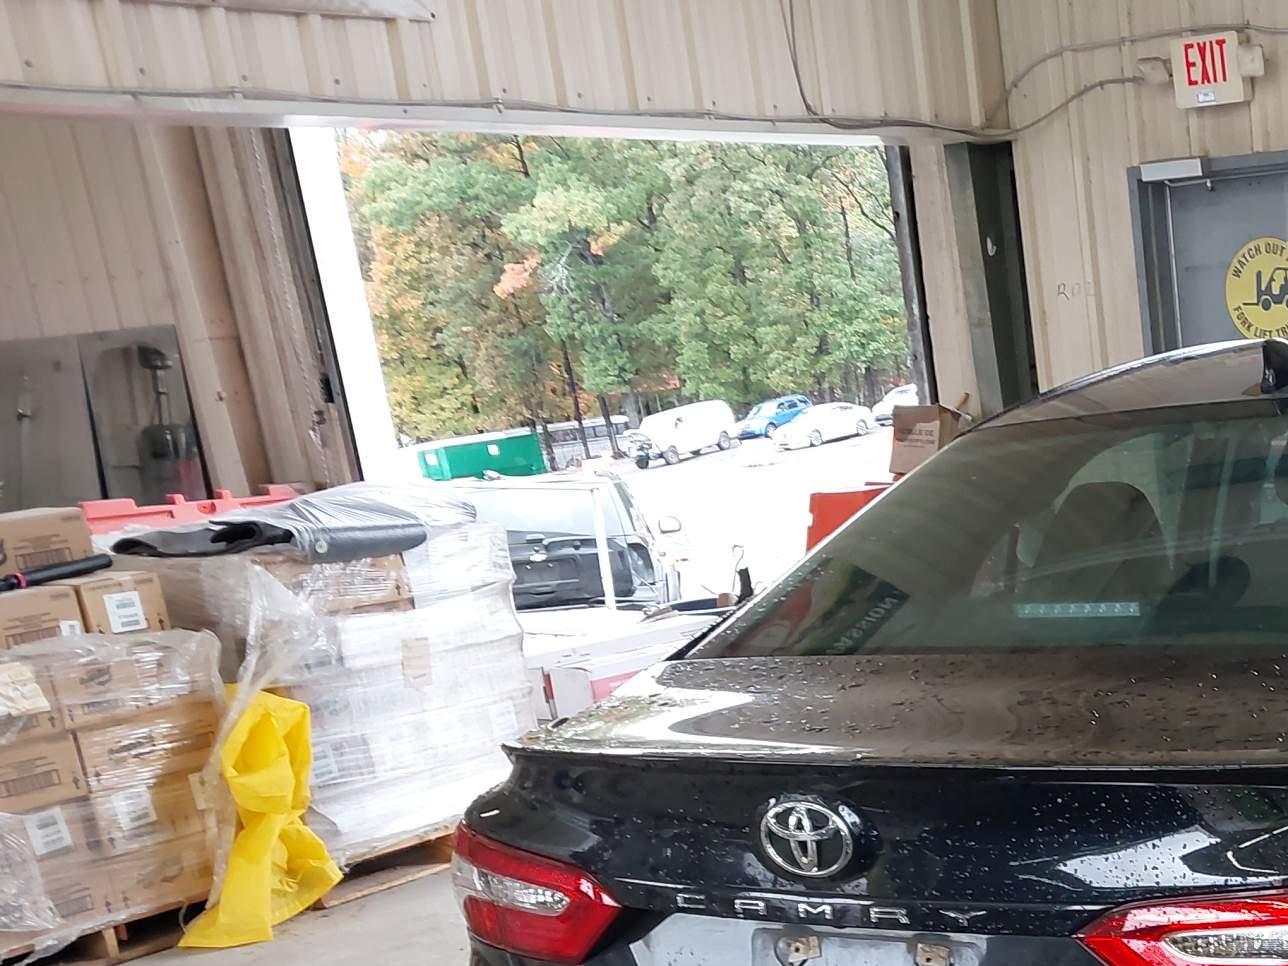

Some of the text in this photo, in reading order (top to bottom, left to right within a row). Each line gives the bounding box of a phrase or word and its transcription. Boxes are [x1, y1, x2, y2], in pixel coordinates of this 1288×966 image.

[1184, 39, 1227, 86] EXIT
[1231, 244, 1262, 279] WATCH
[1264, 242, 1286, 257] OUT
[1233, 305, 1254, 333] FORK
[1254, 327, 1273, 339] LIFT
[676, 893, 988, 926] CAMRY
